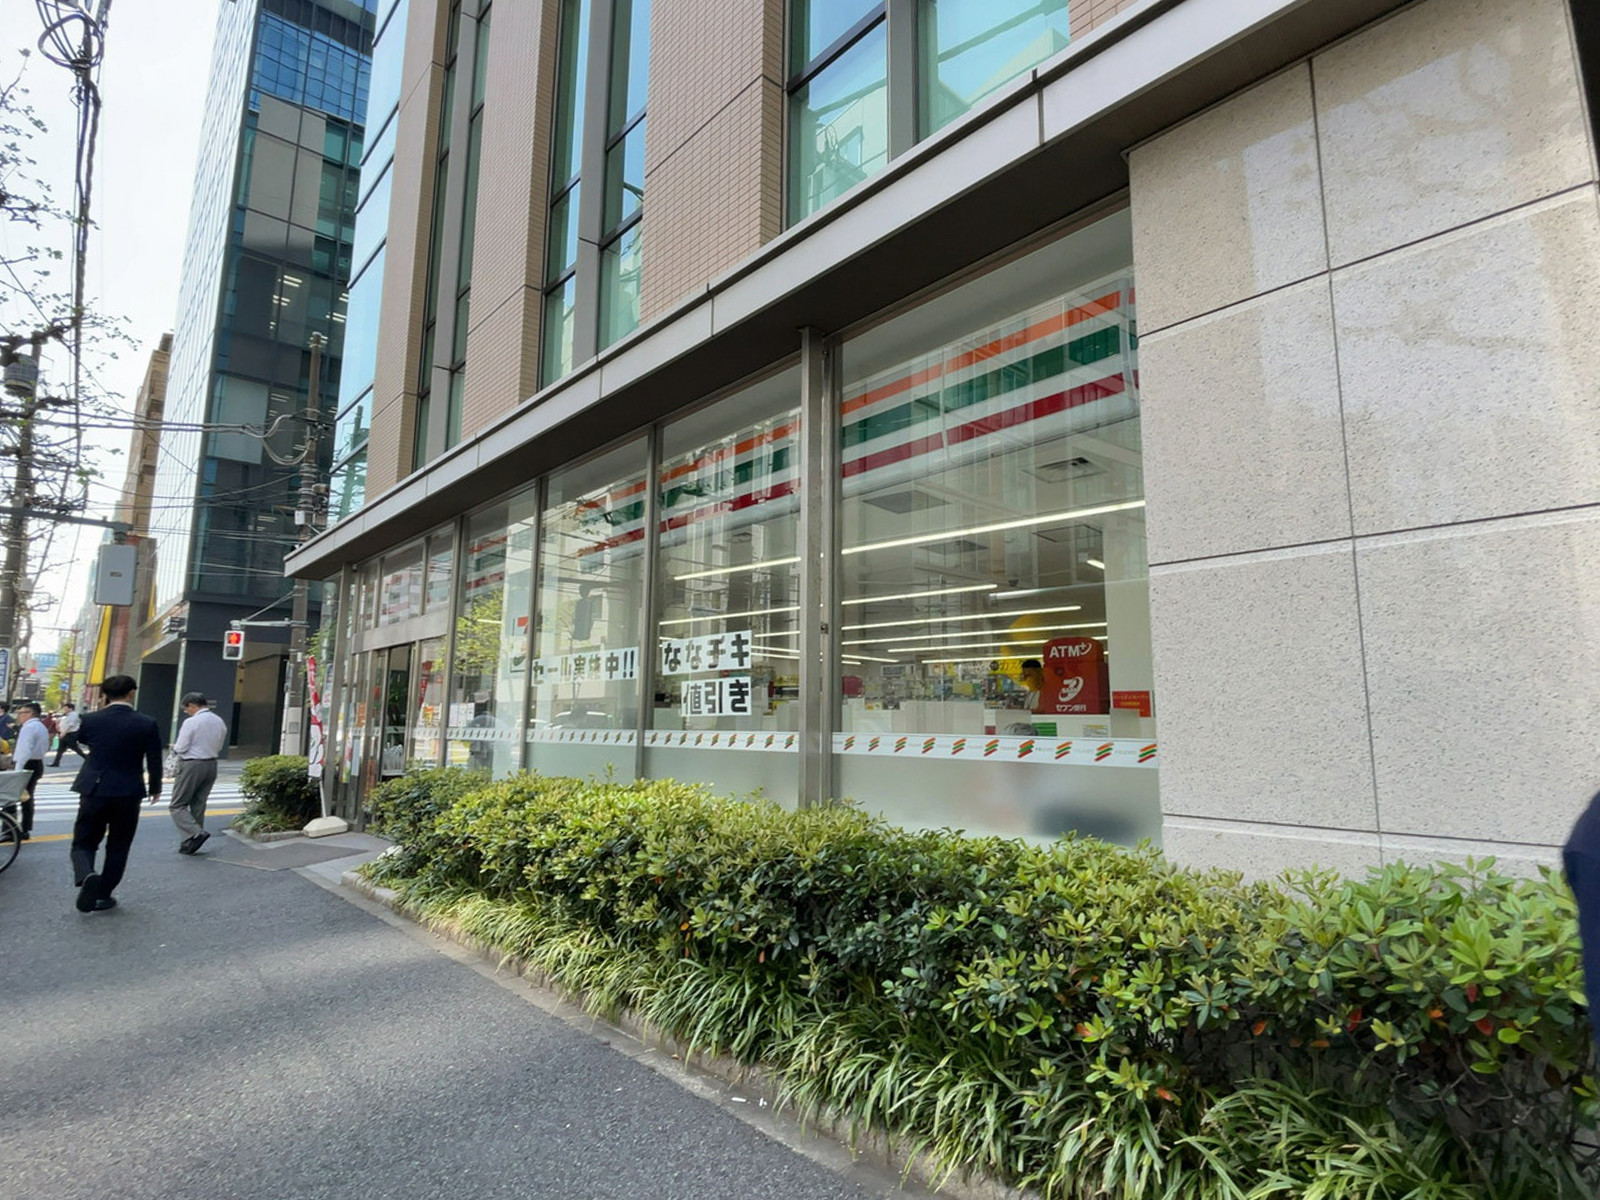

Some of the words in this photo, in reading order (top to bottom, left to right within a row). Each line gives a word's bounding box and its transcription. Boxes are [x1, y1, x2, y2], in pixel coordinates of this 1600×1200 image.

[664, 633, 750, 672] ななチキ
[683, 679, 749, 715] 値引き
